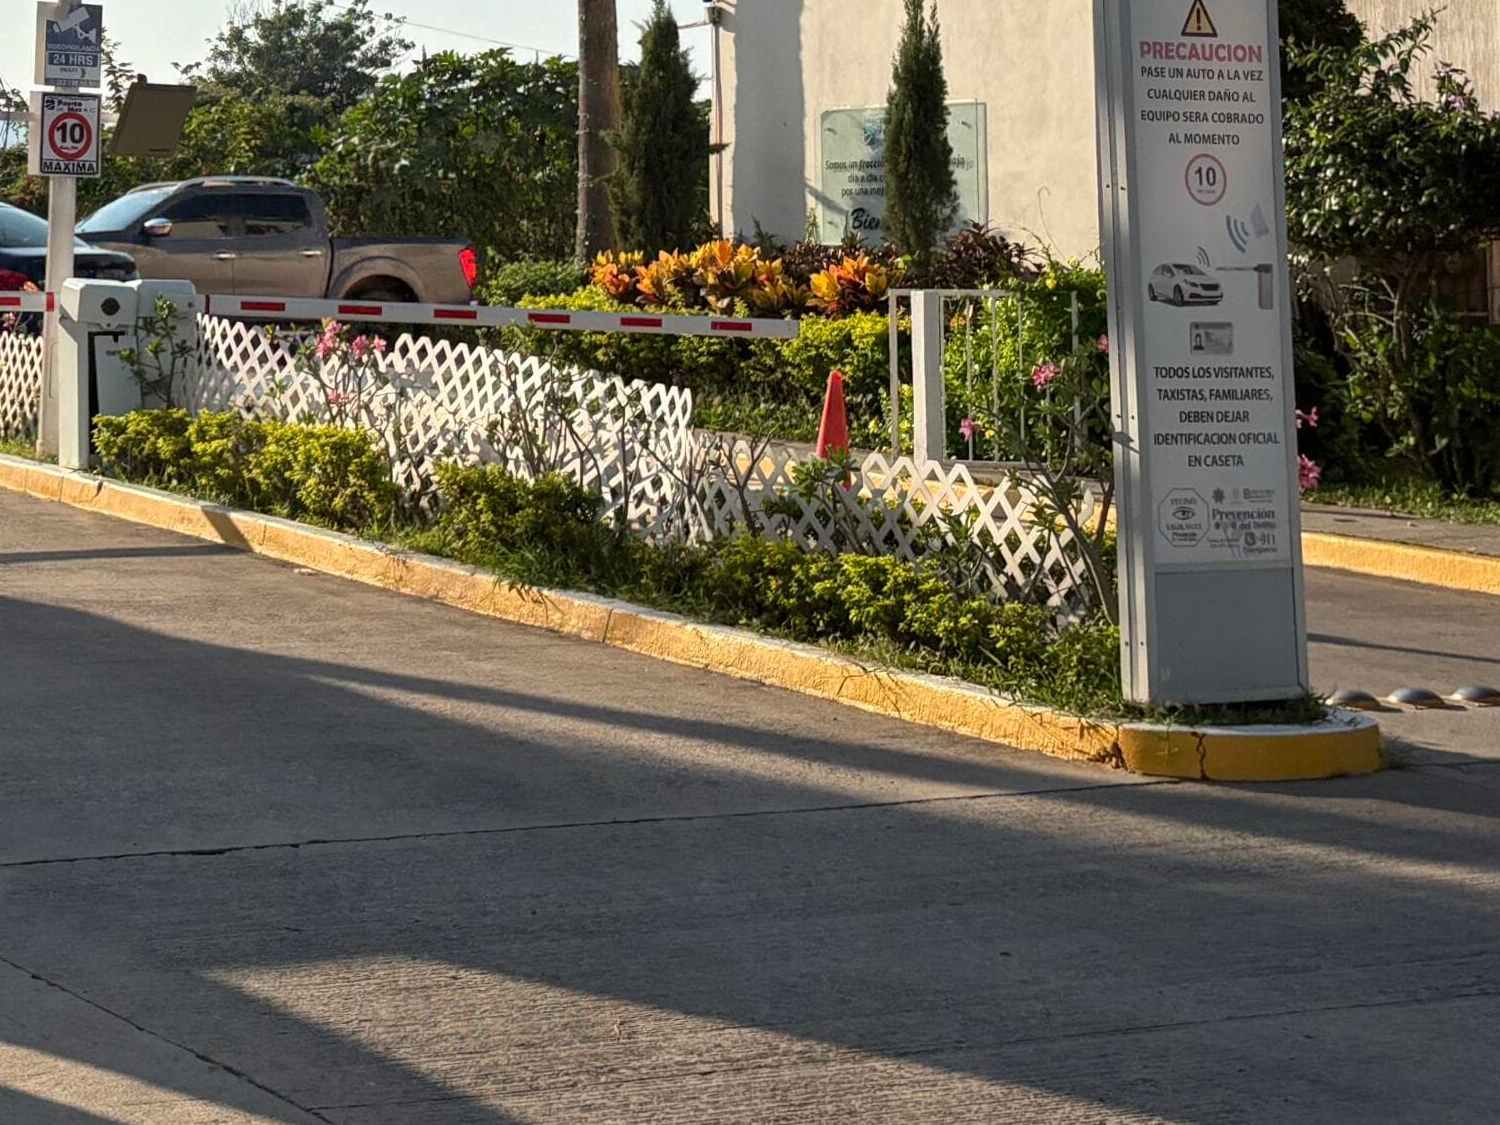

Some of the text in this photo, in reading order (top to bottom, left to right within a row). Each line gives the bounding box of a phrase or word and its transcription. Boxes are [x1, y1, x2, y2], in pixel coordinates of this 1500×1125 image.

[1139, 41, 1262, 63] PRECAUCION
[52, 53, 93, 66] 24 HRS
[1141, 66, 1264, 82] PASE UN AUTO A LA VEZ
[1147, 88, 1256, 103] CUALQUIER DAÑO AL
[1140, 110, 1264, 124] EQUIPO SERA COBRADO
[56, 121, 85, 144] 10
[1168, 133, 1240, 145] AL MOMENTO
[43, 161, 95, 172] MAXIMA
[1194, 166, 1216, 186] 10
[1153, 366, 1274, 380] TODOS LOS VISITANTES,
[1157, 388, 1273, 402] TAXISTAS, FAMILIARES,
[1179, 410, 1250, 423] DEBEN DEJAR
[1154, 432, 1280, 445] IDENTIFICACION OFICIAL
[1188, 455, 1244, 467] EN CASETA
